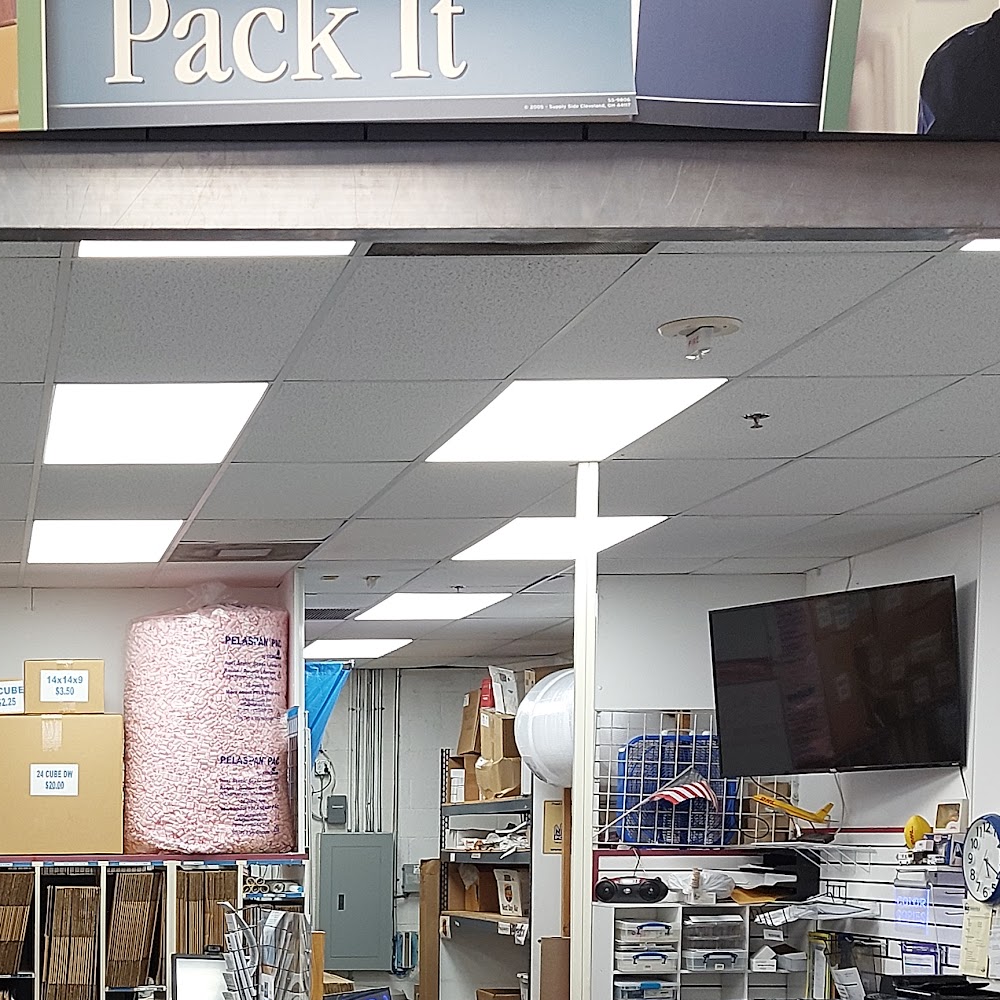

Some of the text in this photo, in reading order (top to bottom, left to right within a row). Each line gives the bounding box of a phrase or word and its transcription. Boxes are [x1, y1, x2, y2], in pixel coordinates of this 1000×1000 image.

[105, 0, 468, 84] Pack It
[46, 675, 84, 685] 14x14x9
[55, 686, 75, 696] $3.50
[36, 770, 74, 779] 24 CUBE DW
[45, 780, 64, 790] $20.00
[976, 826, 982, 838] 11
[983, 822, 991, 833] 12
[970, 838, 978, 850] 10
[968, 852, 974, 864] 9
[970, 868, 976, 880] 8
[976, 881, 980, 892] 7
[982, 886, 988, 898] 6
[896, 896, 927, 906] COLOR
